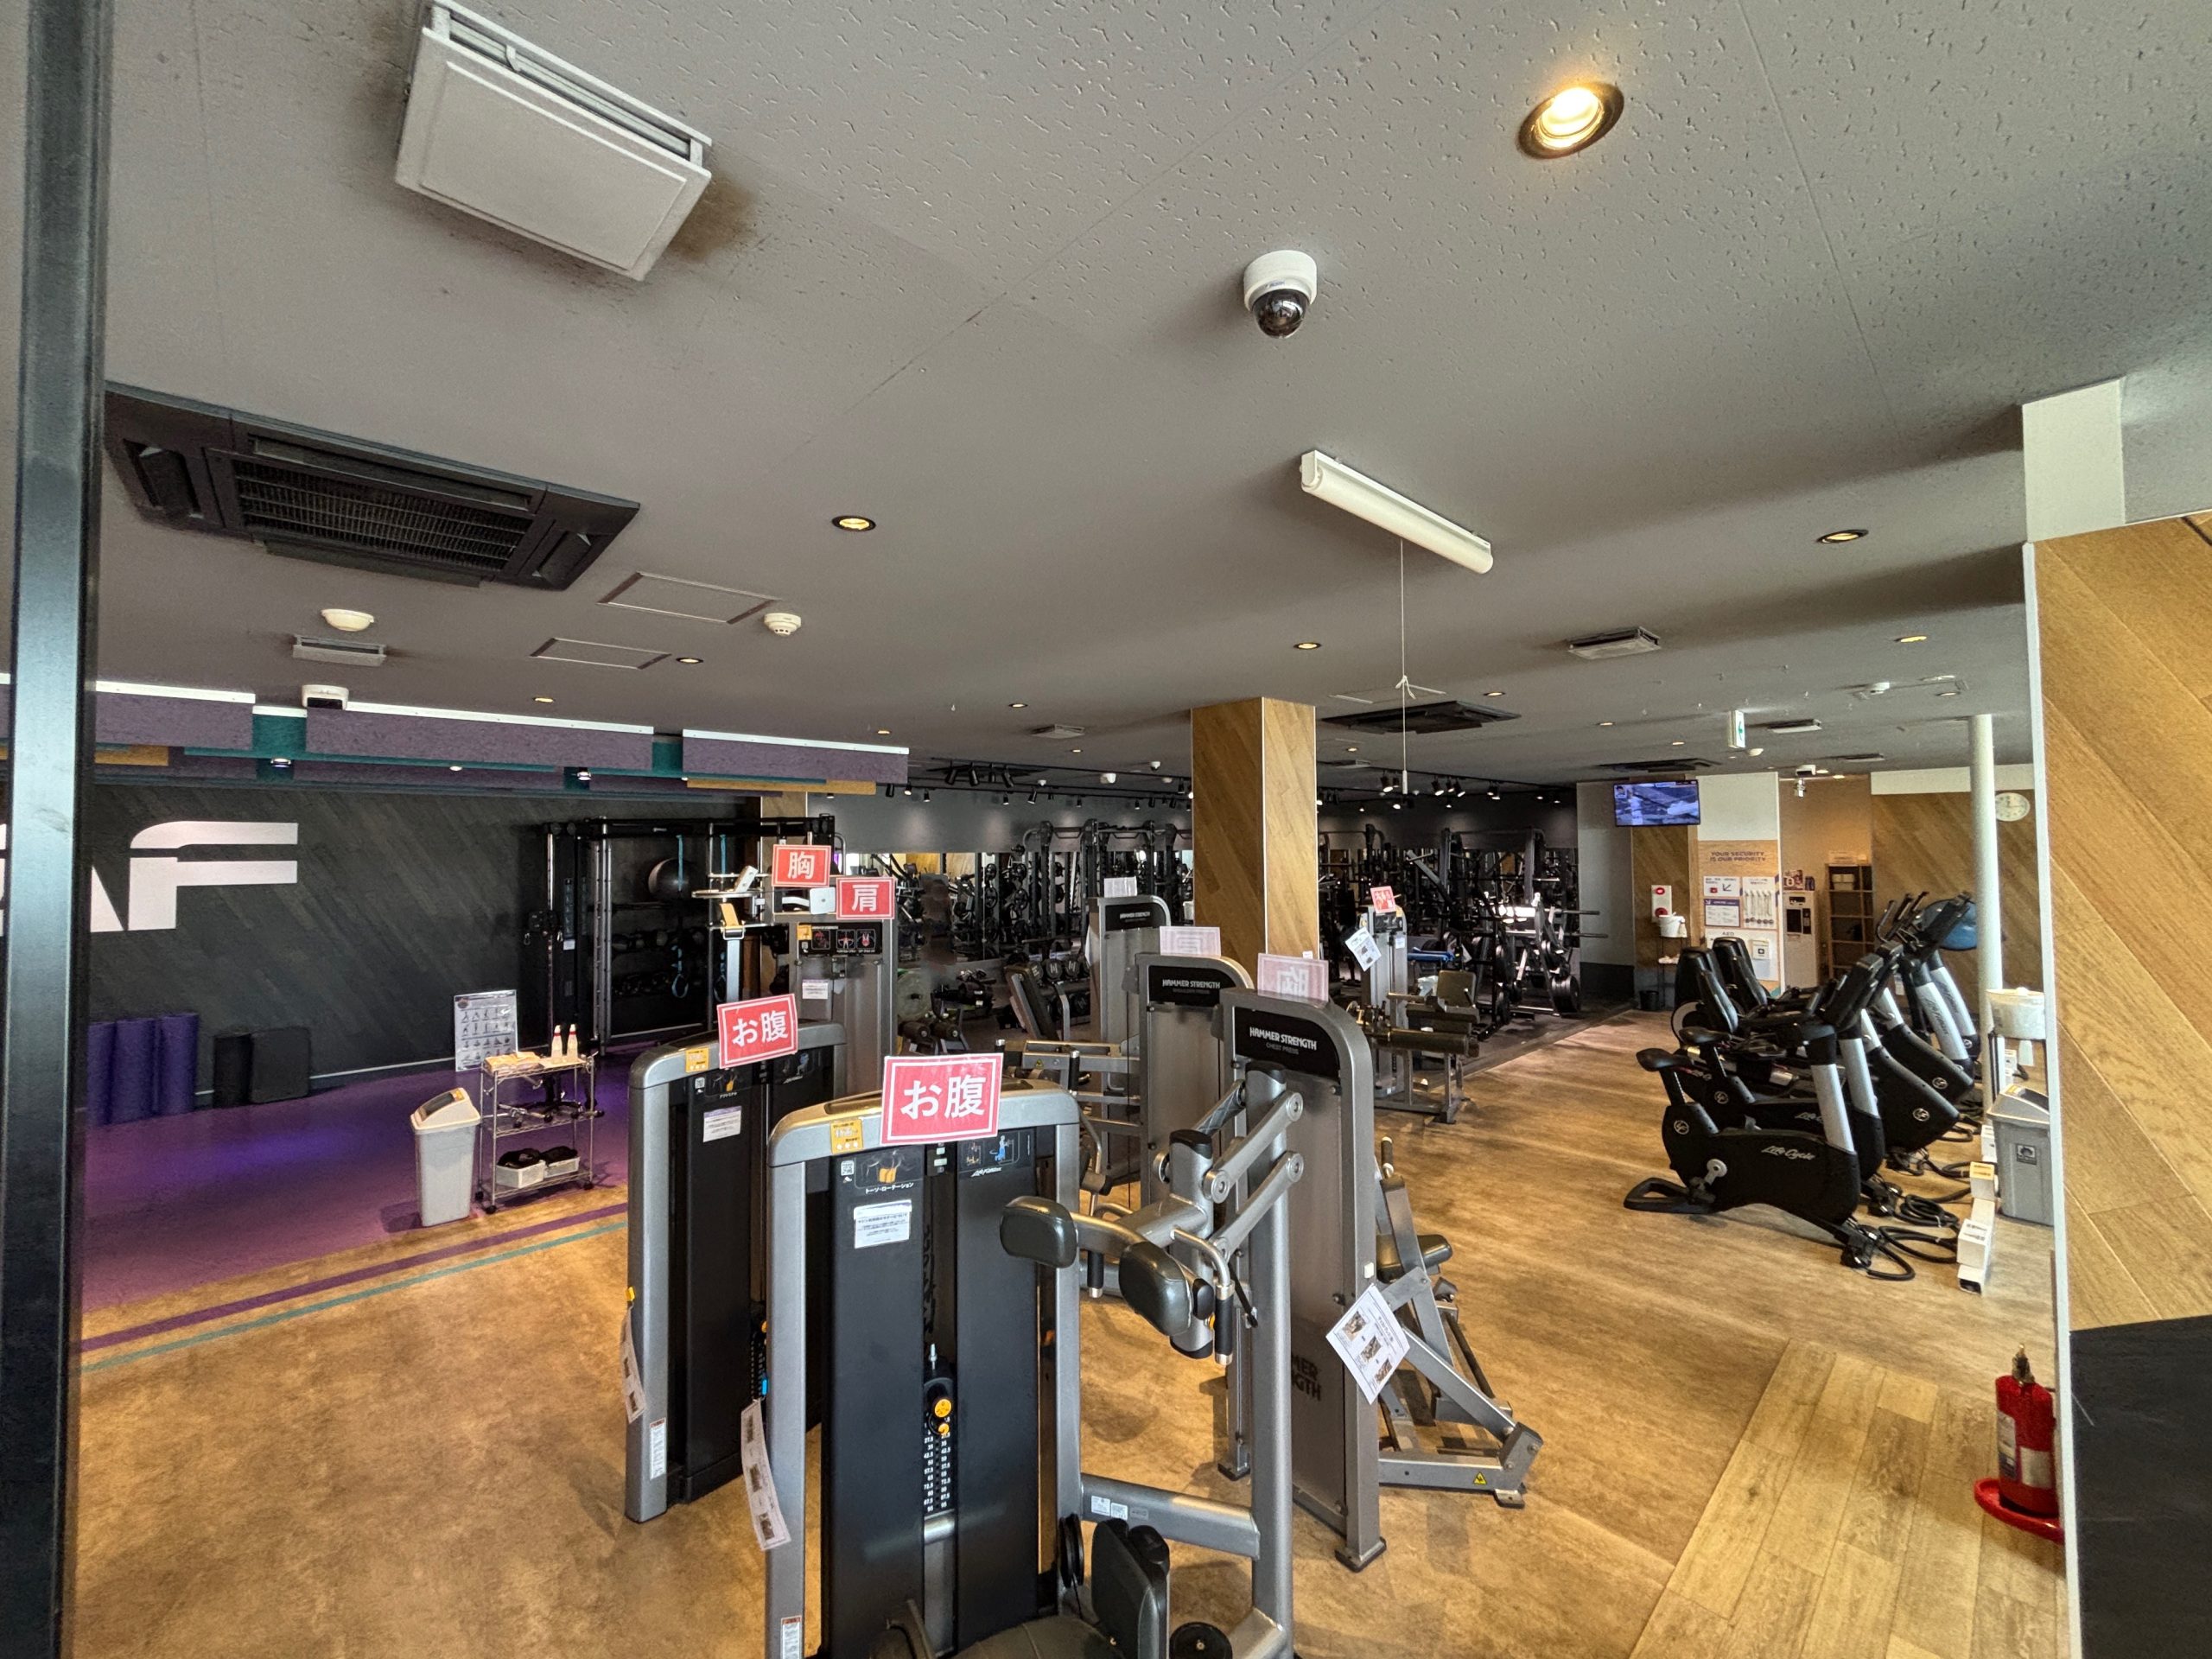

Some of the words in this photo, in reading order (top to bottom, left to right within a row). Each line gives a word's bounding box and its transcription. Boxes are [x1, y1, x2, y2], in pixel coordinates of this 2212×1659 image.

[787, 850, 816, 880] 胸
[851, 883, 879, 912] 肩
[1162, 978, 1190, 988] HAMMER
[1190, 980, 1221, 989] STRENGTH
[732, 1010, 789, 1048] お腹
[1249, 1026, 1280, 1042] HAMMER
[1281, 1033, 1318, 1051] STRENGTH
[900, 1074, 987, 1120] お腹
